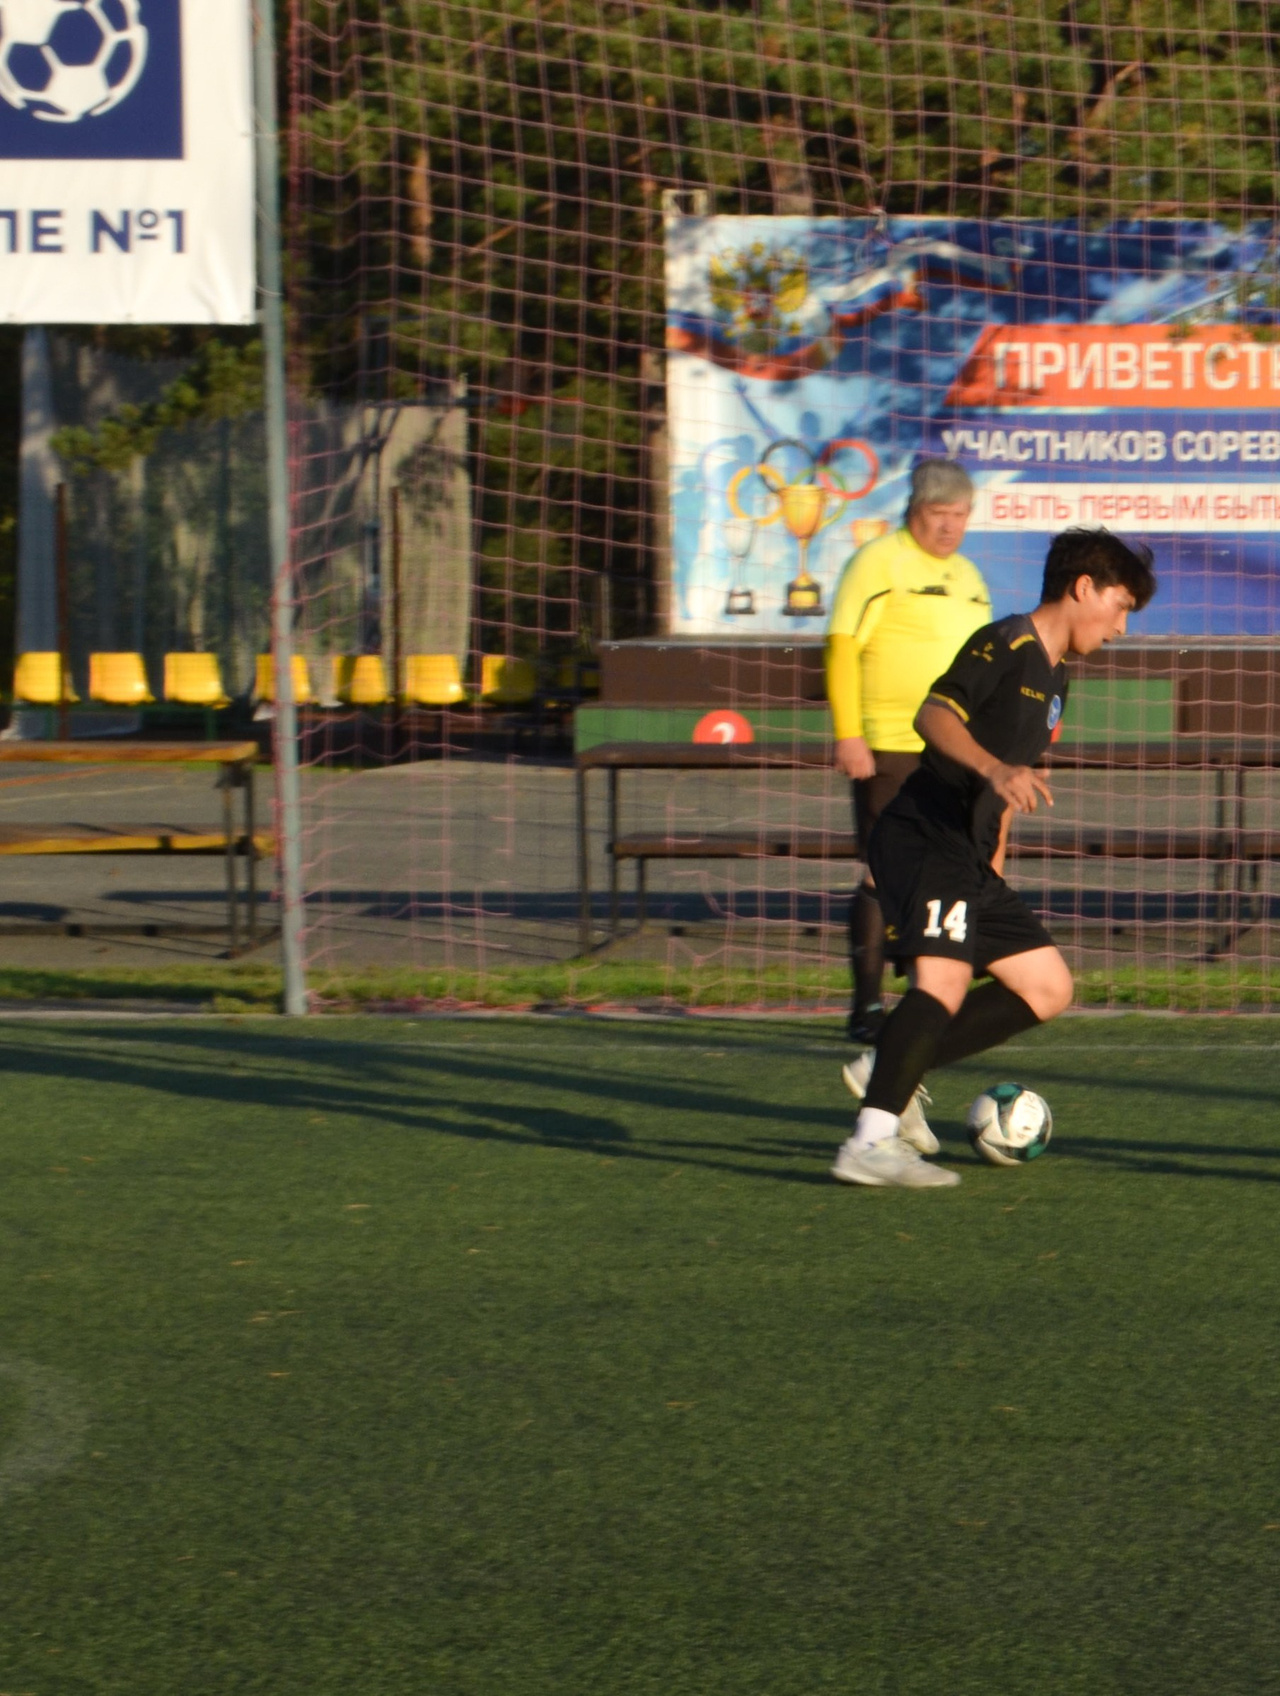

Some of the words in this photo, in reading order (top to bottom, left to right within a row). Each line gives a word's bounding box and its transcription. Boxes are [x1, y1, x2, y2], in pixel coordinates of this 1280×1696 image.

[941, 430, 1167, 462] УЧАСТНИКОВ
[992, 494, 1072, 520] БЫТЬ
[1080, 494, 1208, 520] ПЕРВЫМ
[923, 899, 968, 943] 14
